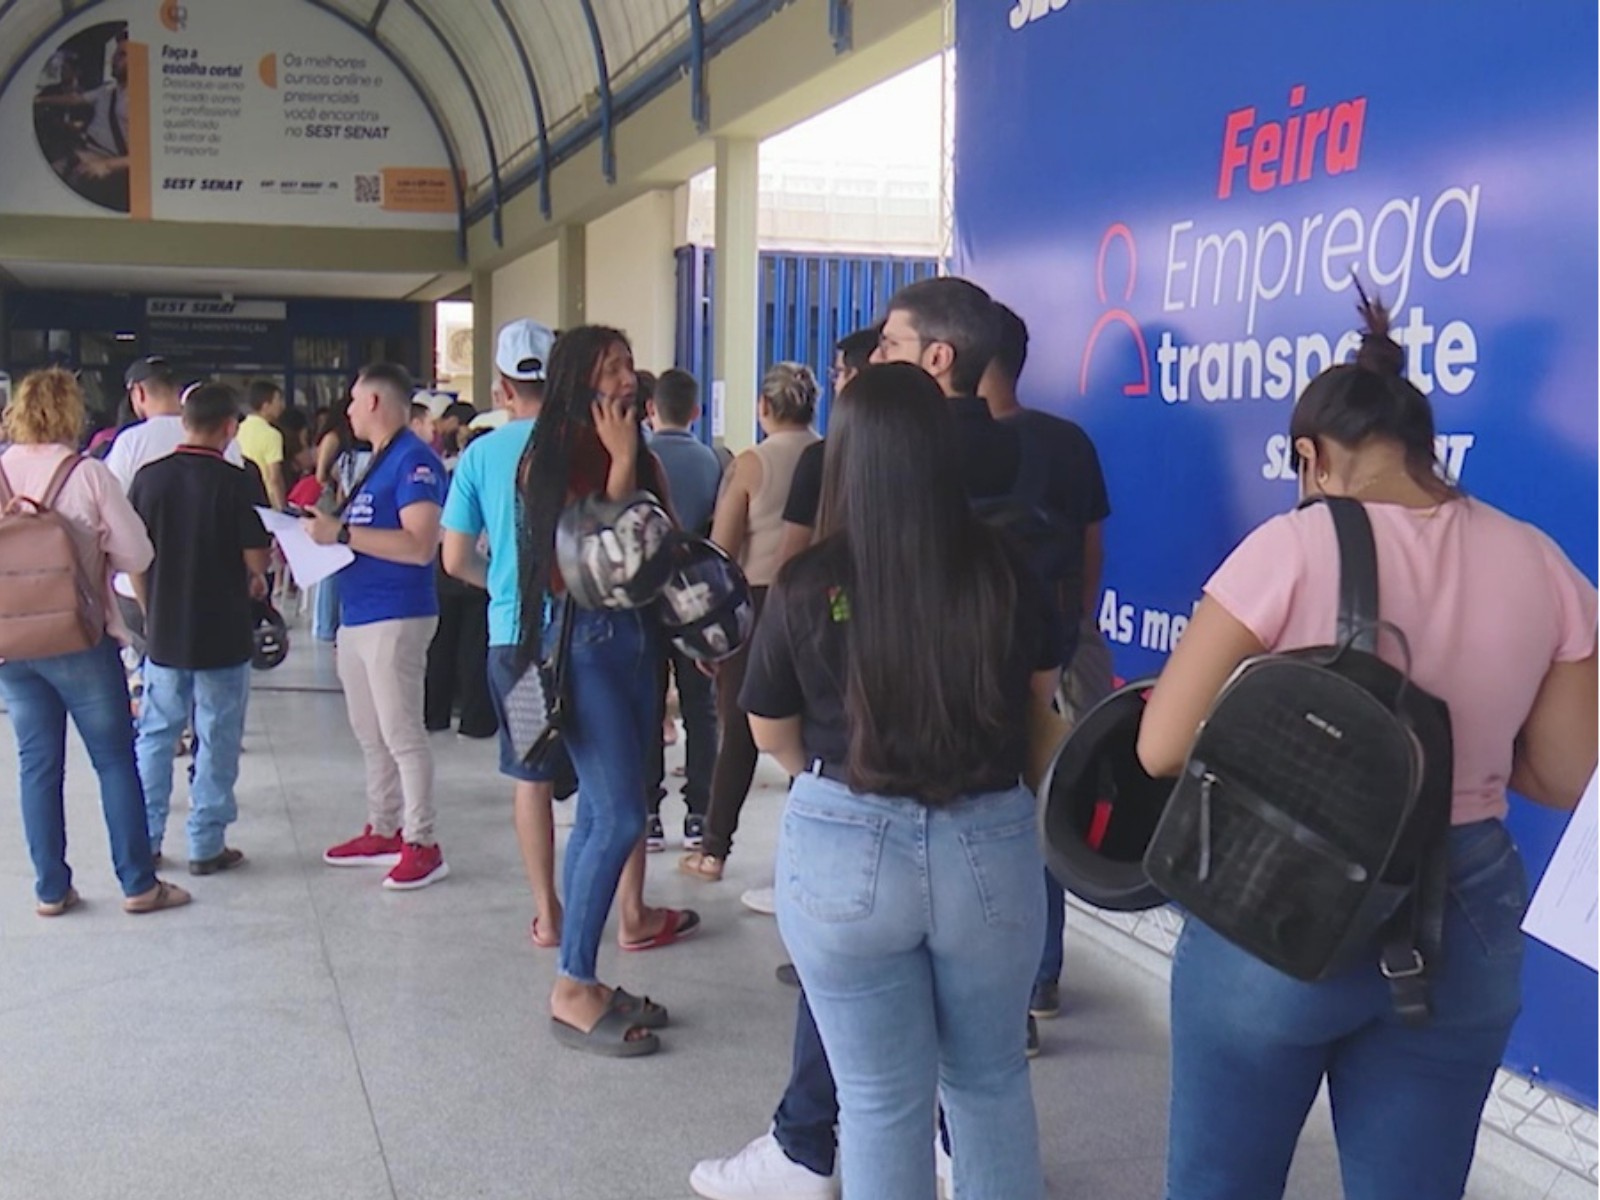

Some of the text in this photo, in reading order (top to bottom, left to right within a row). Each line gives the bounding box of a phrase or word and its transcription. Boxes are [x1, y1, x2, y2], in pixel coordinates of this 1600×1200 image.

[162, 44, 188, 60] Faça
[162, 62, 206, 75] escolha
[283, 53, 366, 69] Os melhores
[284, 73, 383, 87] cursos online e
[284, 91, 359, 104] presenciais
[284, 107, 379, 122] você encontra
[285, 124, 390, 140] no SEST SENAT
[1218, 86, 1367, 199] Feira
[163, 178, 243, 192] SEST SENAT
[1163, 184, 1481, 334] Emprega
[150, 302, 187, 313] SEST
[1098, 589, 1135, 645] As
